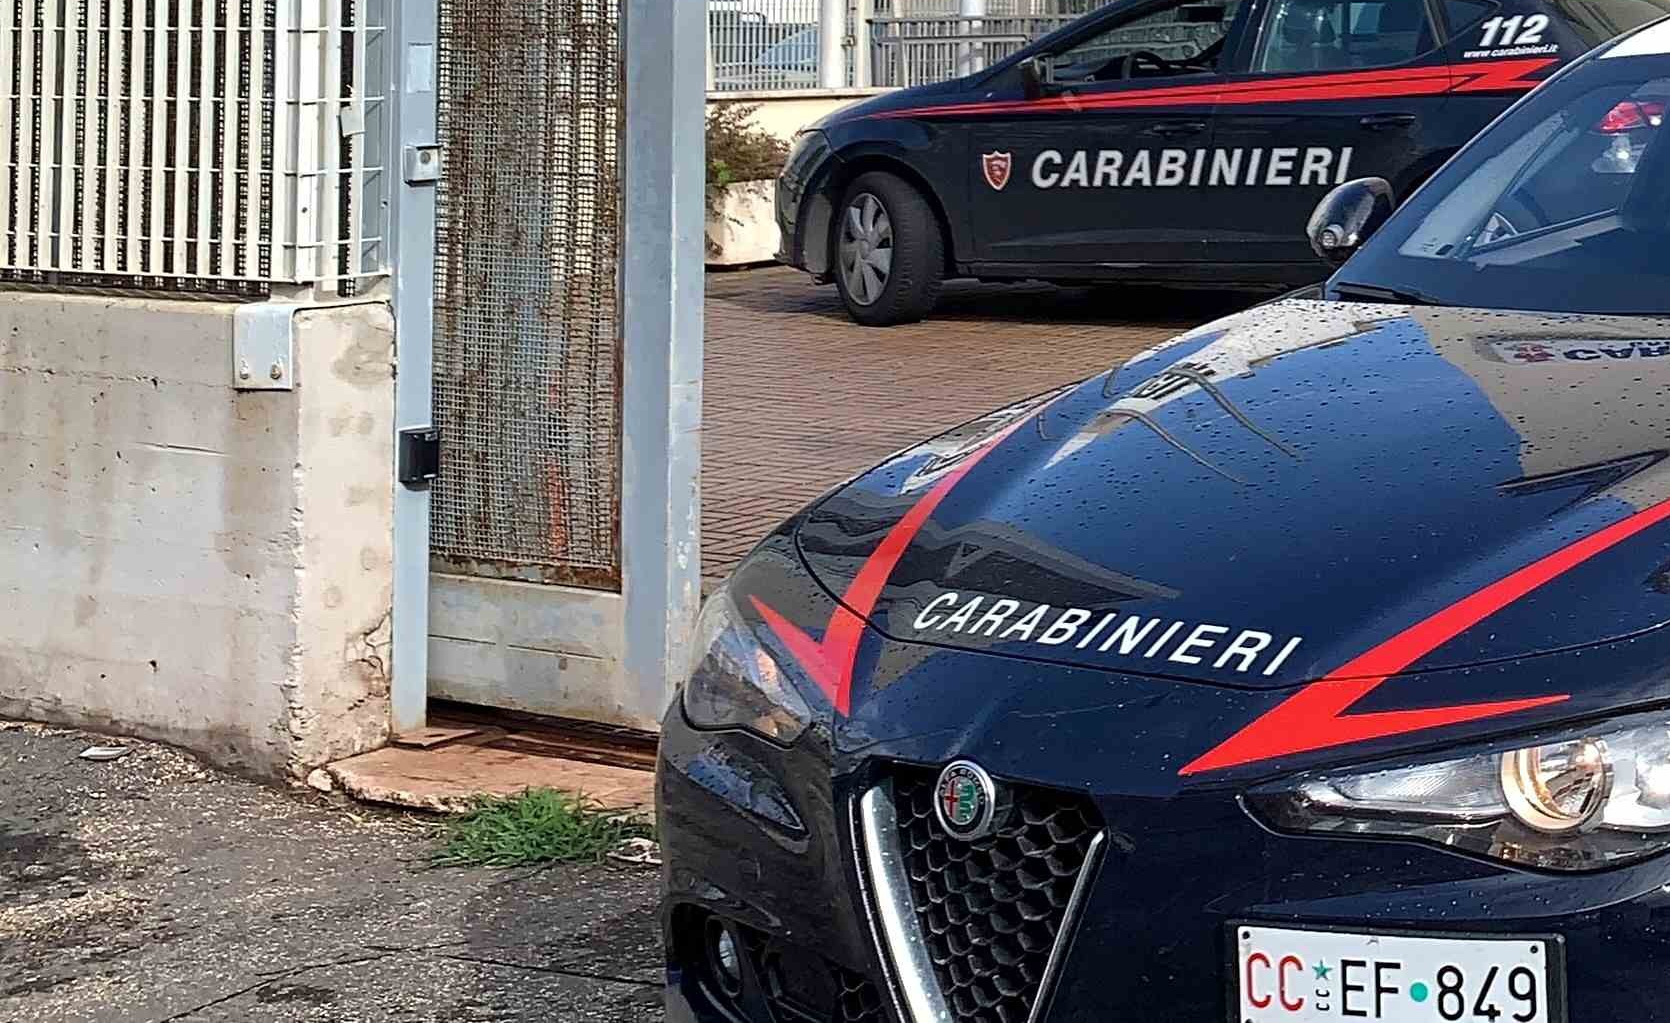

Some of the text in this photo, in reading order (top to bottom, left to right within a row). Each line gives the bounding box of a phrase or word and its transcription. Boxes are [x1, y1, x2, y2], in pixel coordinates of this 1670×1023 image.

[1479, 13, 1550, 47] 112
[1031, 146, 1353, 189] CARABINIERI
[912, 591, 1303, 676] CARABINIERI
[1245, 952, 1538, 1022] CC EF 849
